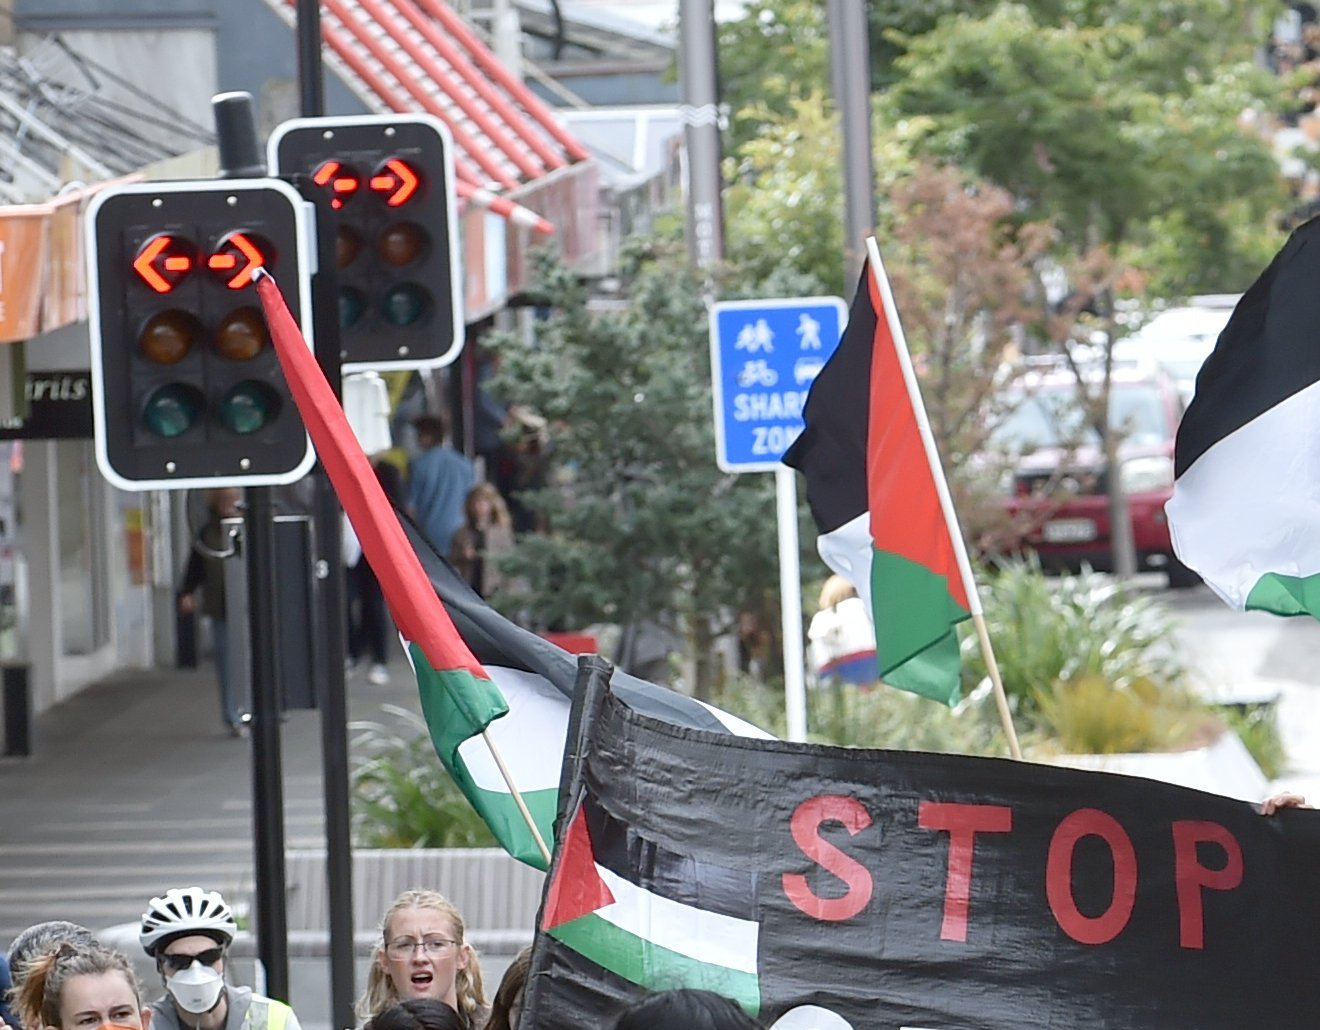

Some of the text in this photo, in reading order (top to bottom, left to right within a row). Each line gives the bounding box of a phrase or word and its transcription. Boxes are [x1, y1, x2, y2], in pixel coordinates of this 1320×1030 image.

[733, 392, 809, 421] SHAR
[751, 426, 804, 454] ZON
[781, 794, 1244, 949] STOP
